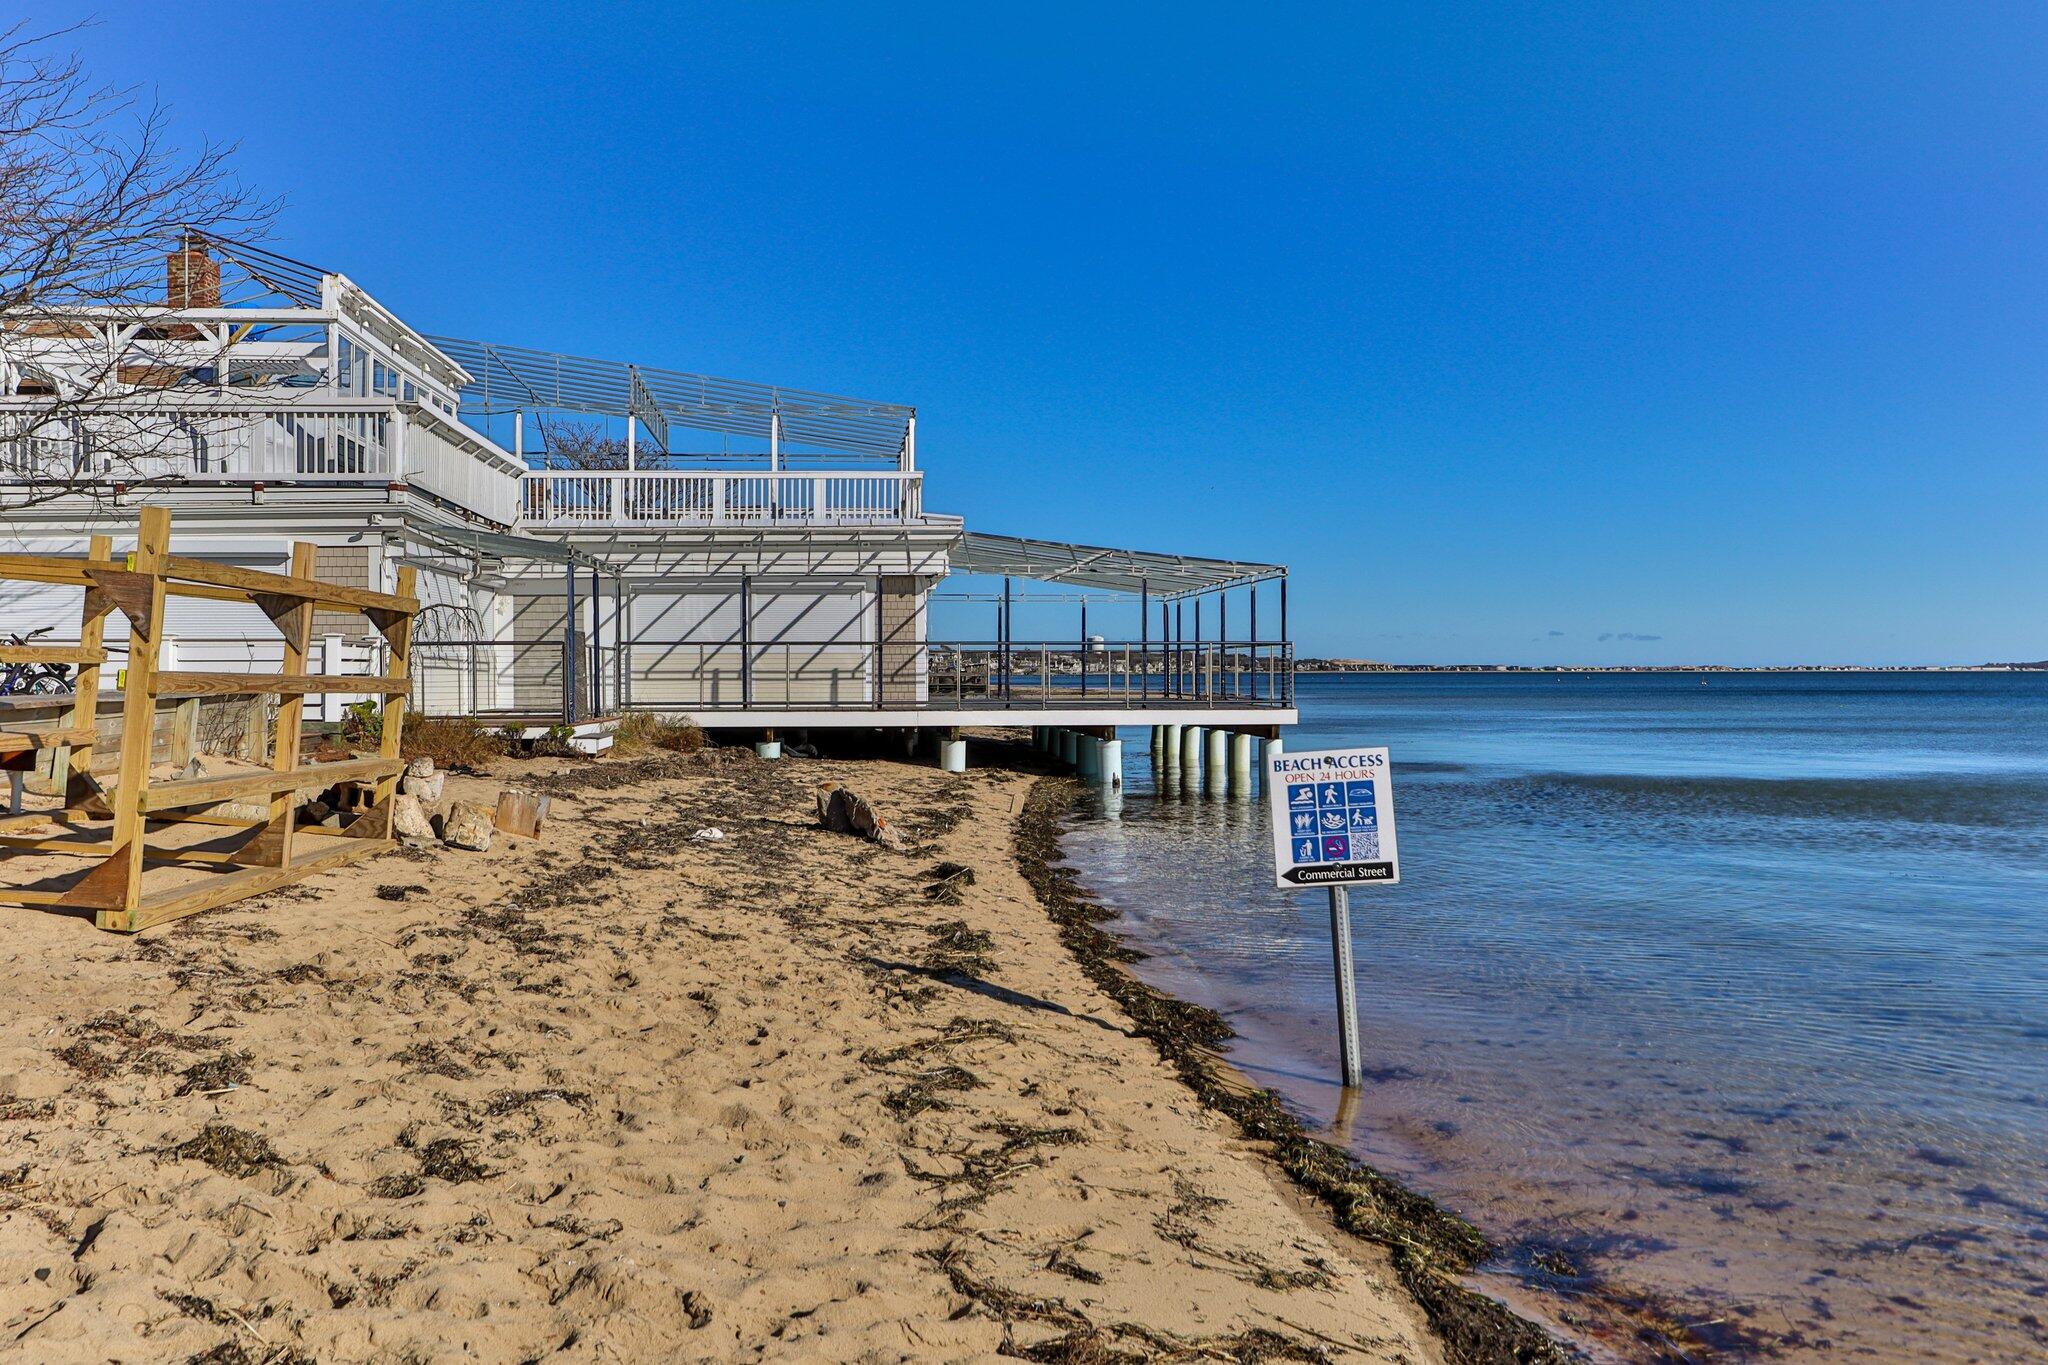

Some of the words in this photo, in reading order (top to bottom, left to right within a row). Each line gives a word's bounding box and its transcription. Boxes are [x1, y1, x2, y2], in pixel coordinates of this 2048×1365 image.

[1274, 758, 1322, 772] BEACH
[1328, 754, 1383, 769] ACCESS
[1285, 773, 1315, 783] OPEN
[1320, 772, 1331, 781] 24
[1335, 769, 1375, 780] HOURS
[1298, 868, 1355, 880] Commercial
[1358, 867, 1387, 878] Street
